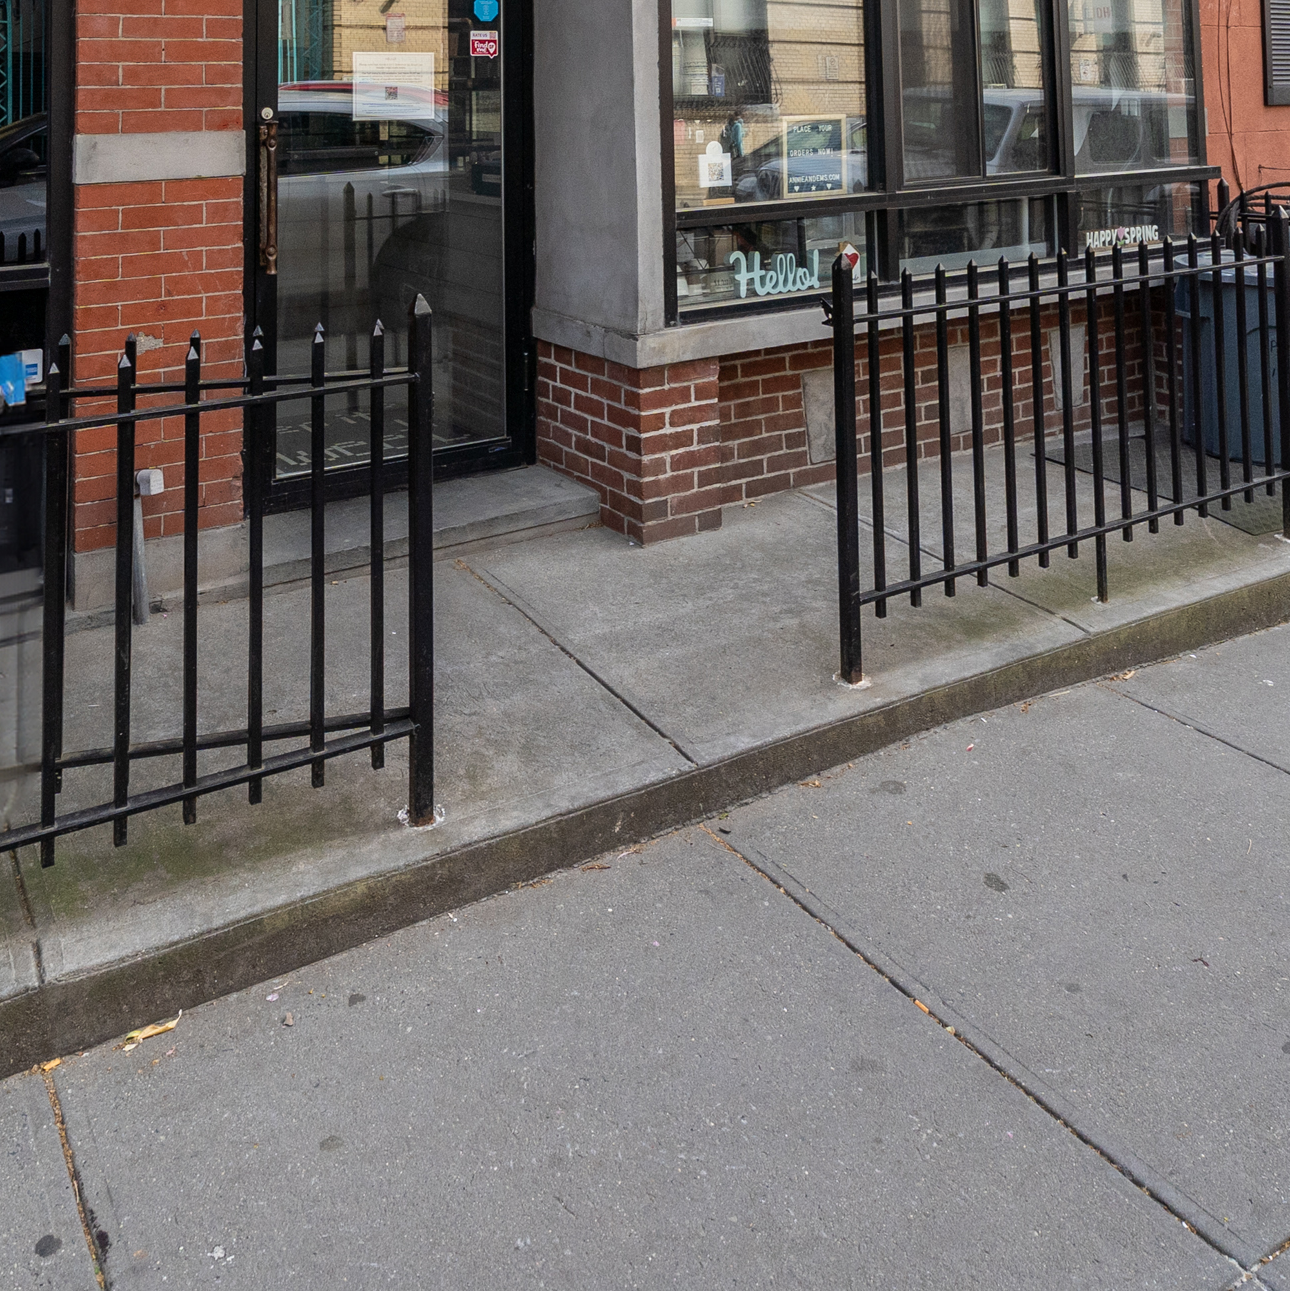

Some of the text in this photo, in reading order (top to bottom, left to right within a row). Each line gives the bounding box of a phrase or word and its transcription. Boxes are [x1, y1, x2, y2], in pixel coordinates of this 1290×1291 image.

[793, 124, 832, 133] PLACE YOUR
[790, 148, 834, 157] ORDERS NOW!
[789, 174, 840, 183] ANNIEANDEMS.COM
[1086, 225, 1159, 248] HAPPY SPRING
[727, 249, 820, 298] Hello!
